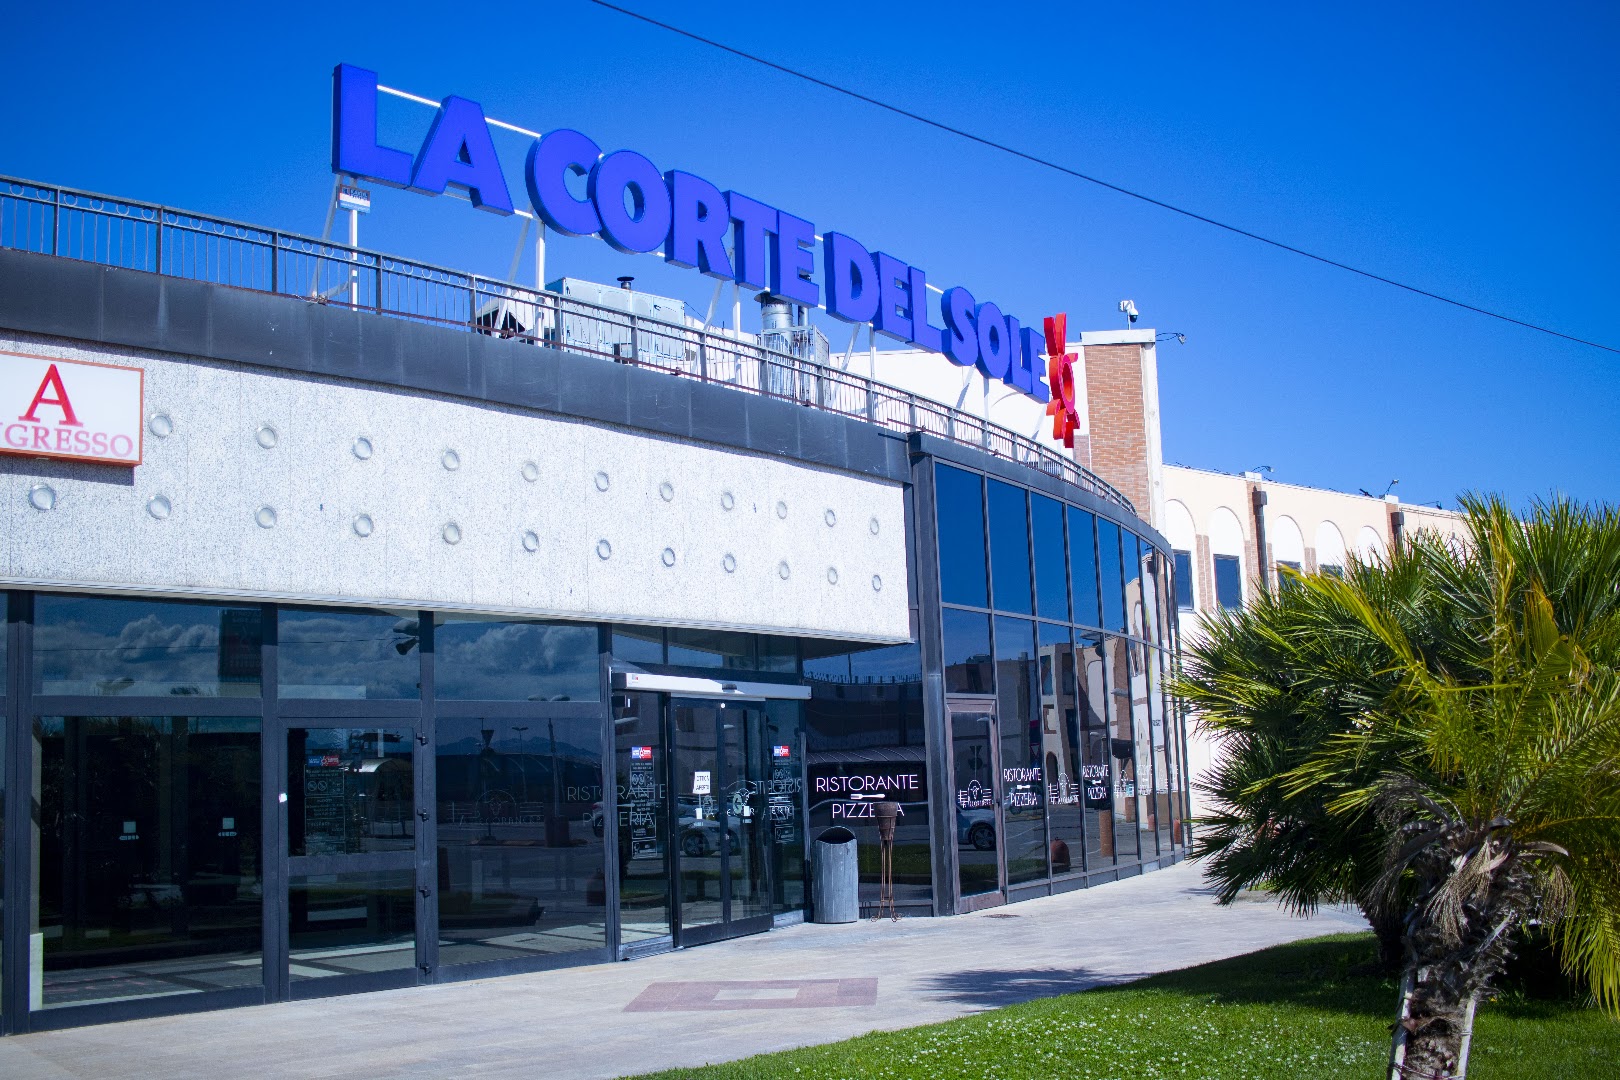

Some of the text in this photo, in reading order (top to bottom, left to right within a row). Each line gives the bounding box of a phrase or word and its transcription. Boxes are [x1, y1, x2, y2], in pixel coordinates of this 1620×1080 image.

[332, 63, 1049, 403] LA CORTE DEL SOLE
[18, 361, 83, 426] A
[0, 422, 134, 458] GRESSO
[567, 784, 665, 801] RISTRANTE
[816, 774, 919, 793] RISTORANTE
[832, 802, 905, 819] PIZZEA
